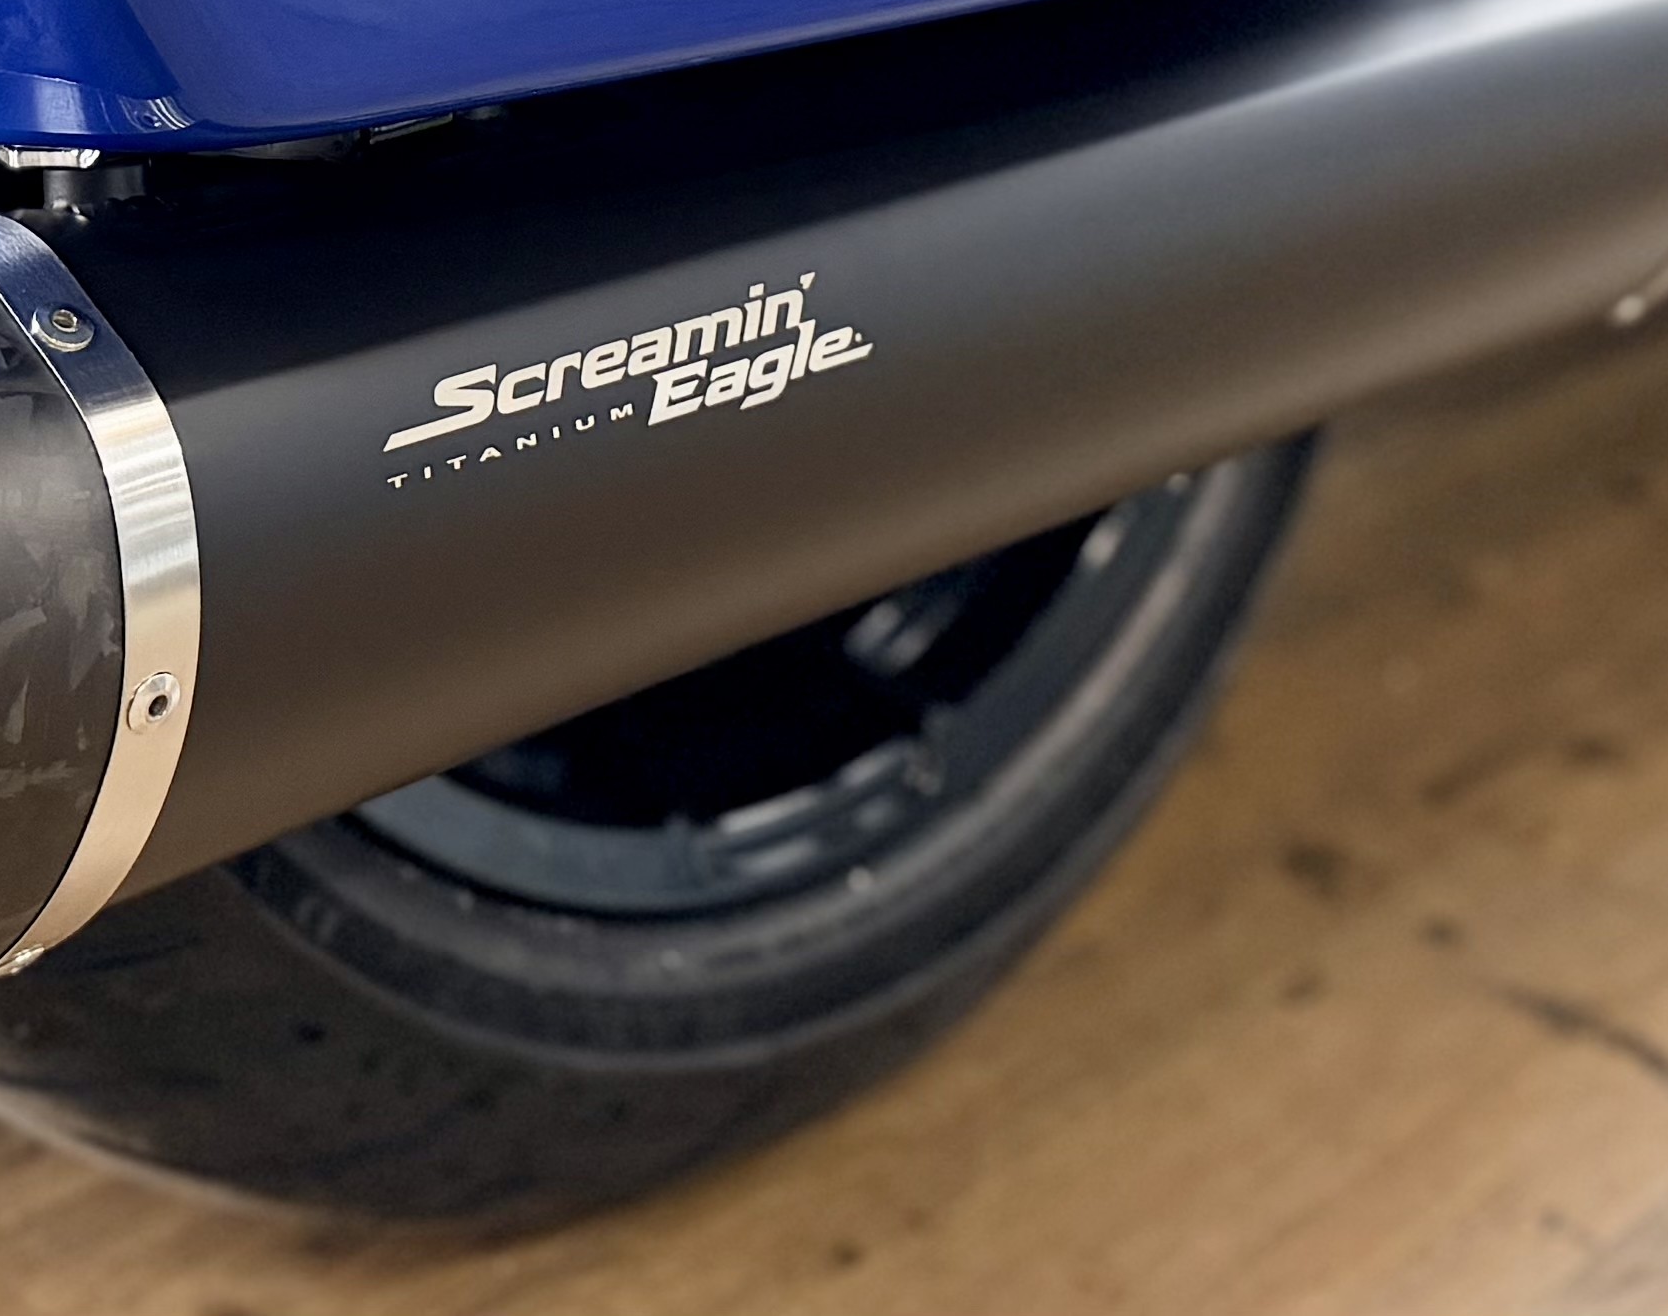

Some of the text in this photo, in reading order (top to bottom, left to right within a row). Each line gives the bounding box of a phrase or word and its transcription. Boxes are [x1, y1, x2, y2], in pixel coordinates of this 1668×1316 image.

[382, 272, 816, 452] Screamin'
[648, 319, 873, 426] Eagle
[387, 404, 634, 490] TITANIUM
